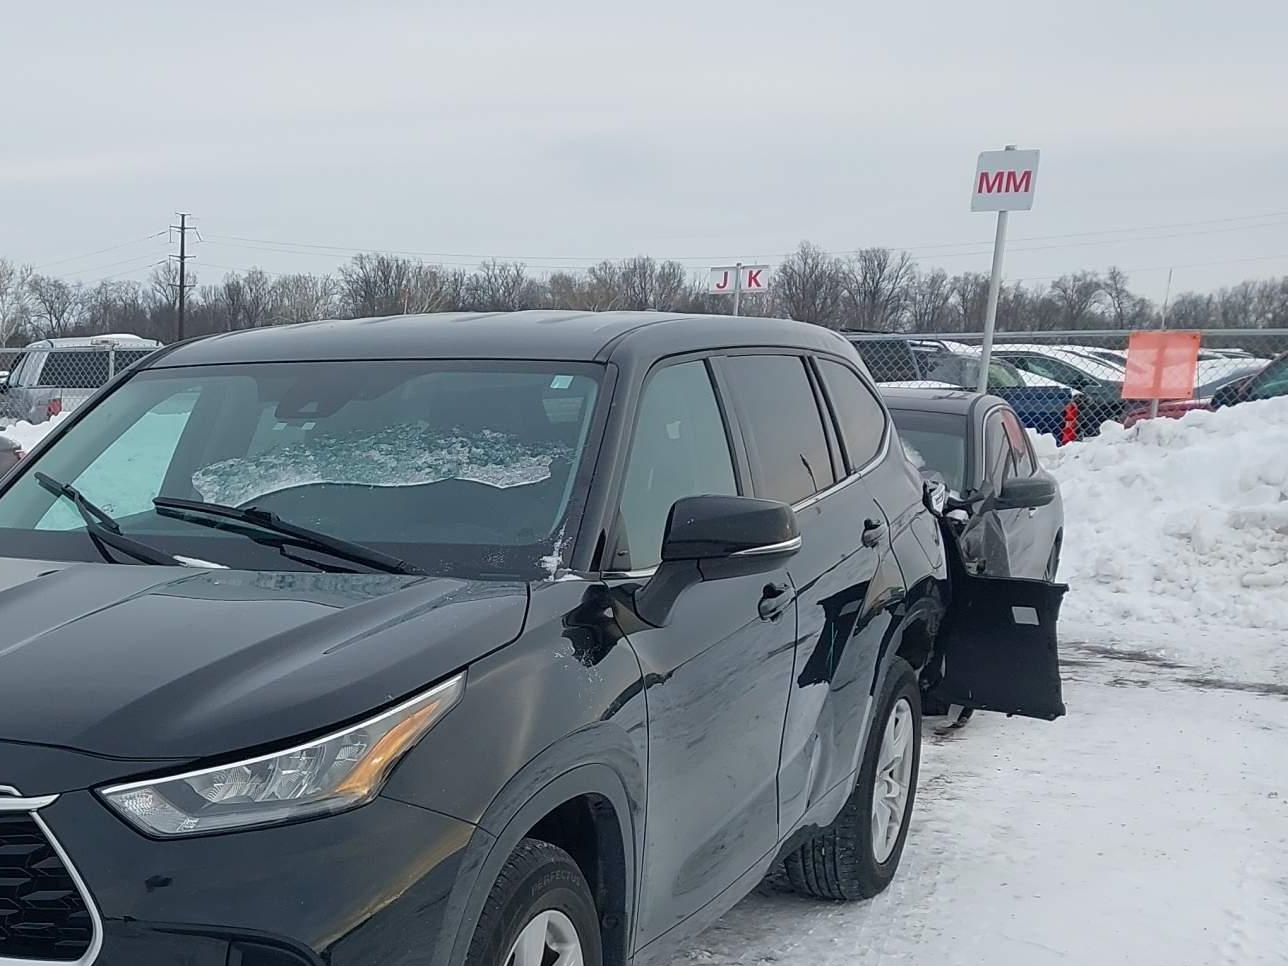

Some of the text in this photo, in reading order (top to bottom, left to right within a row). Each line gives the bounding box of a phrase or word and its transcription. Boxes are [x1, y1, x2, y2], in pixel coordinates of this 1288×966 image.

[978, 170, 1032, 193] MM
[716, 271, 729, 289] J
[748, 270, 762, 288] K
